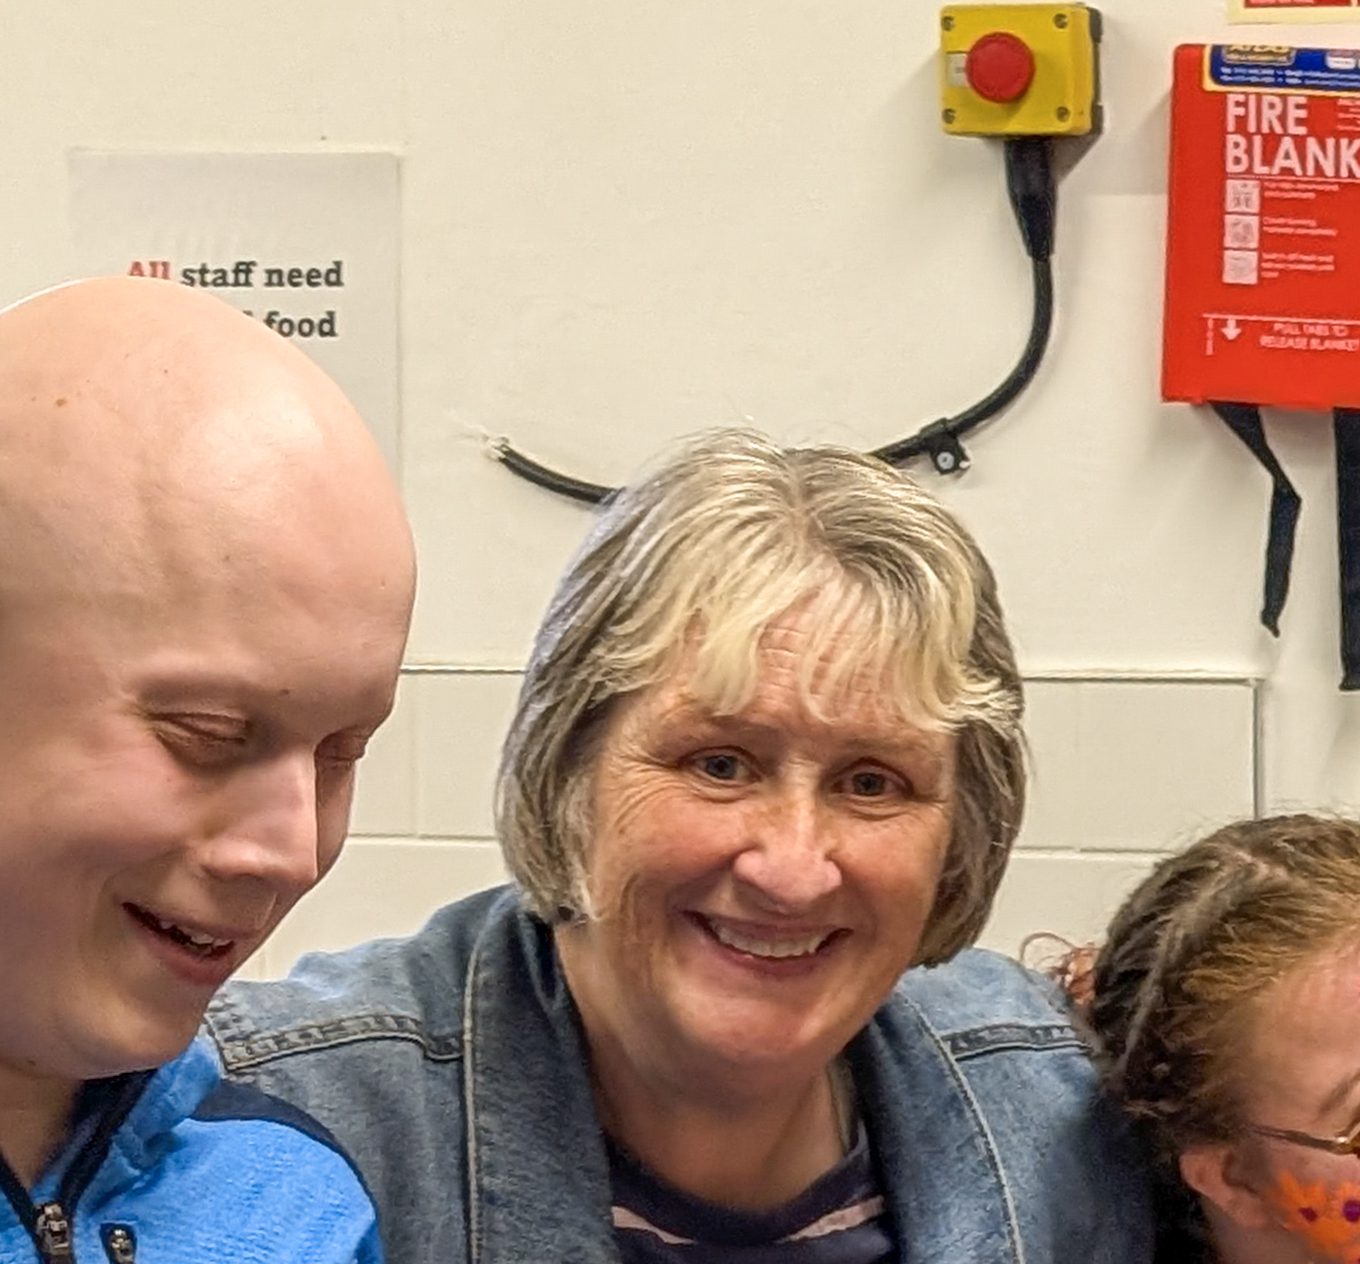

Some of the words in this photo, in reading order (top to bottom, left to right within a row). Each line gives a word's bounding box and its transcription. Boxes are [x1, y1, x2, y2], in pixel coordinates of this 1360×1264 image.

[1226, 93, 1308, 135] FIRE
[127, 259, 172, 281] All
[180, 260, 258, 287] staff
[263, 260, 344, 287] need
[263, 310, 337, 338] food
[1309, 337, 1360, 351] BLANKET
